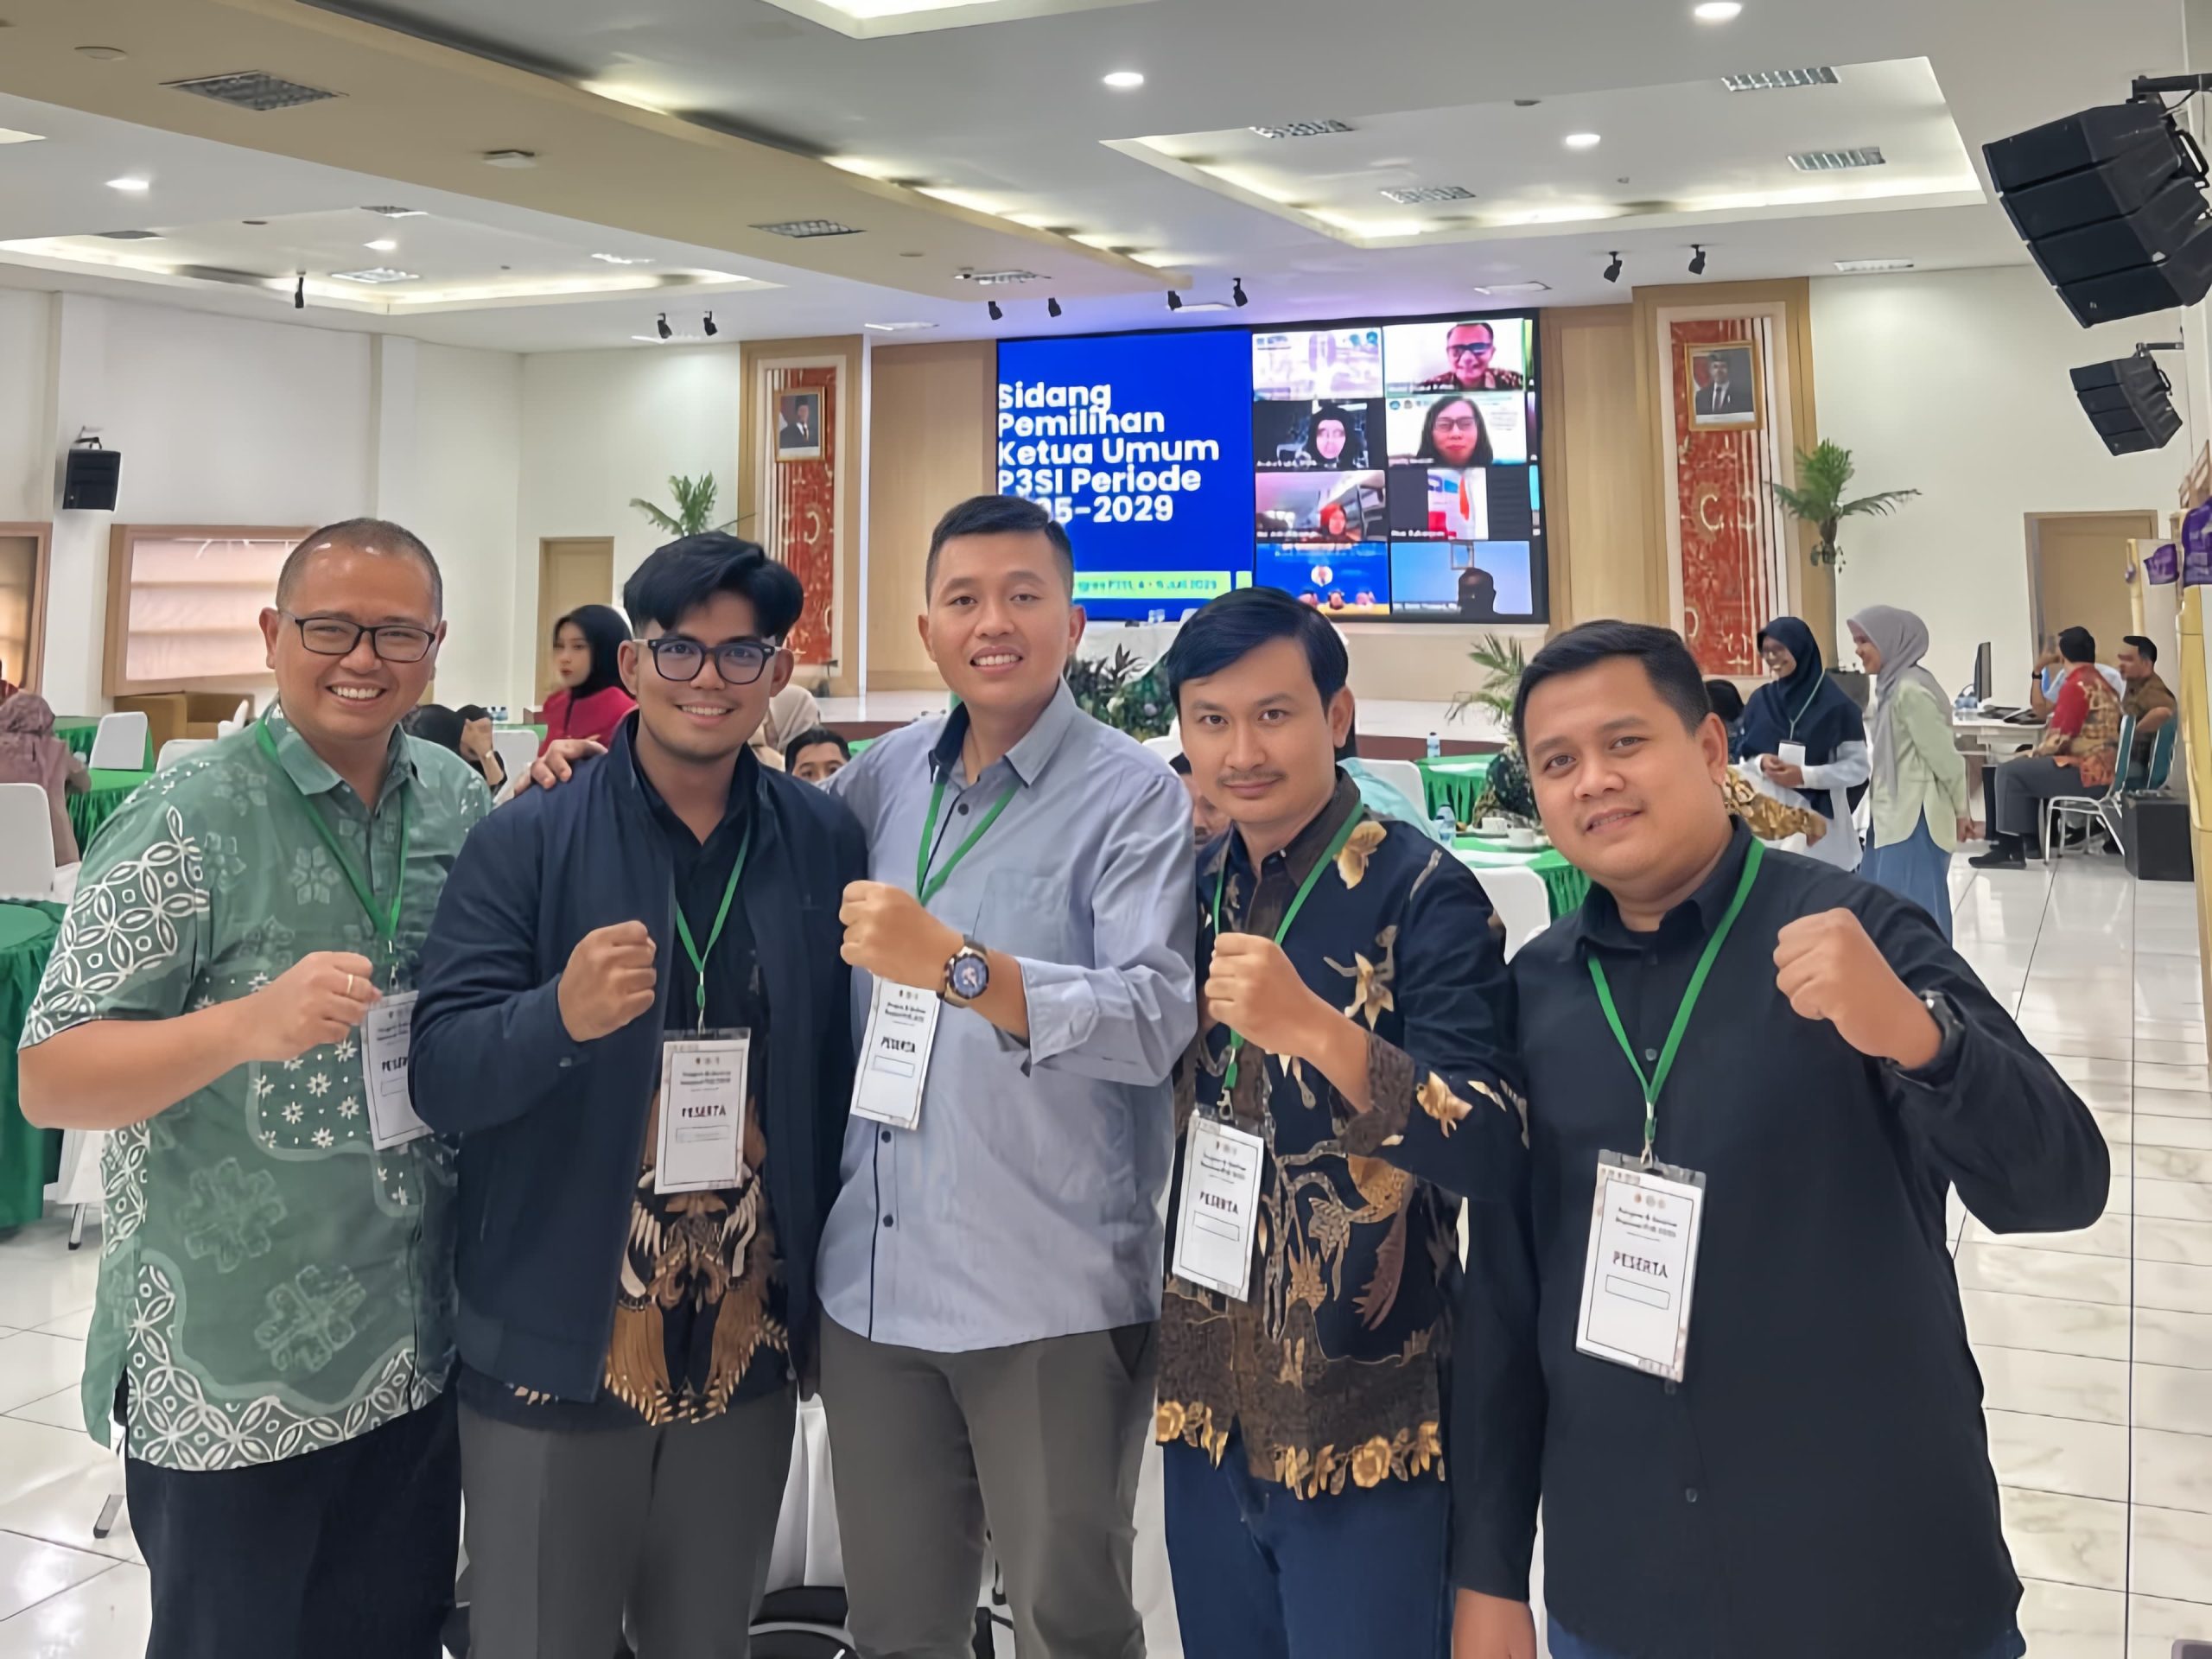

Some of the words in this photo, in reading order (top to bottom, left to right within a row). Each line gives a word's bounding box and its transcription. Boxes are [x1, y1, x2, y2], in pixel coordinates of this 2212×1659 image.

[998, 380, 1111, 412] Sidang
[998, 405, 1165, 438] Pemilihan
[998, 439, 1093, 467] Ketua
[1102, 437, 1220, 464] Umum
[998, 467, 1064, 496] P3SI
[1071, 463, 1202, 494] Periode
[1612, 1250, 1669, 1279] PESERTA
